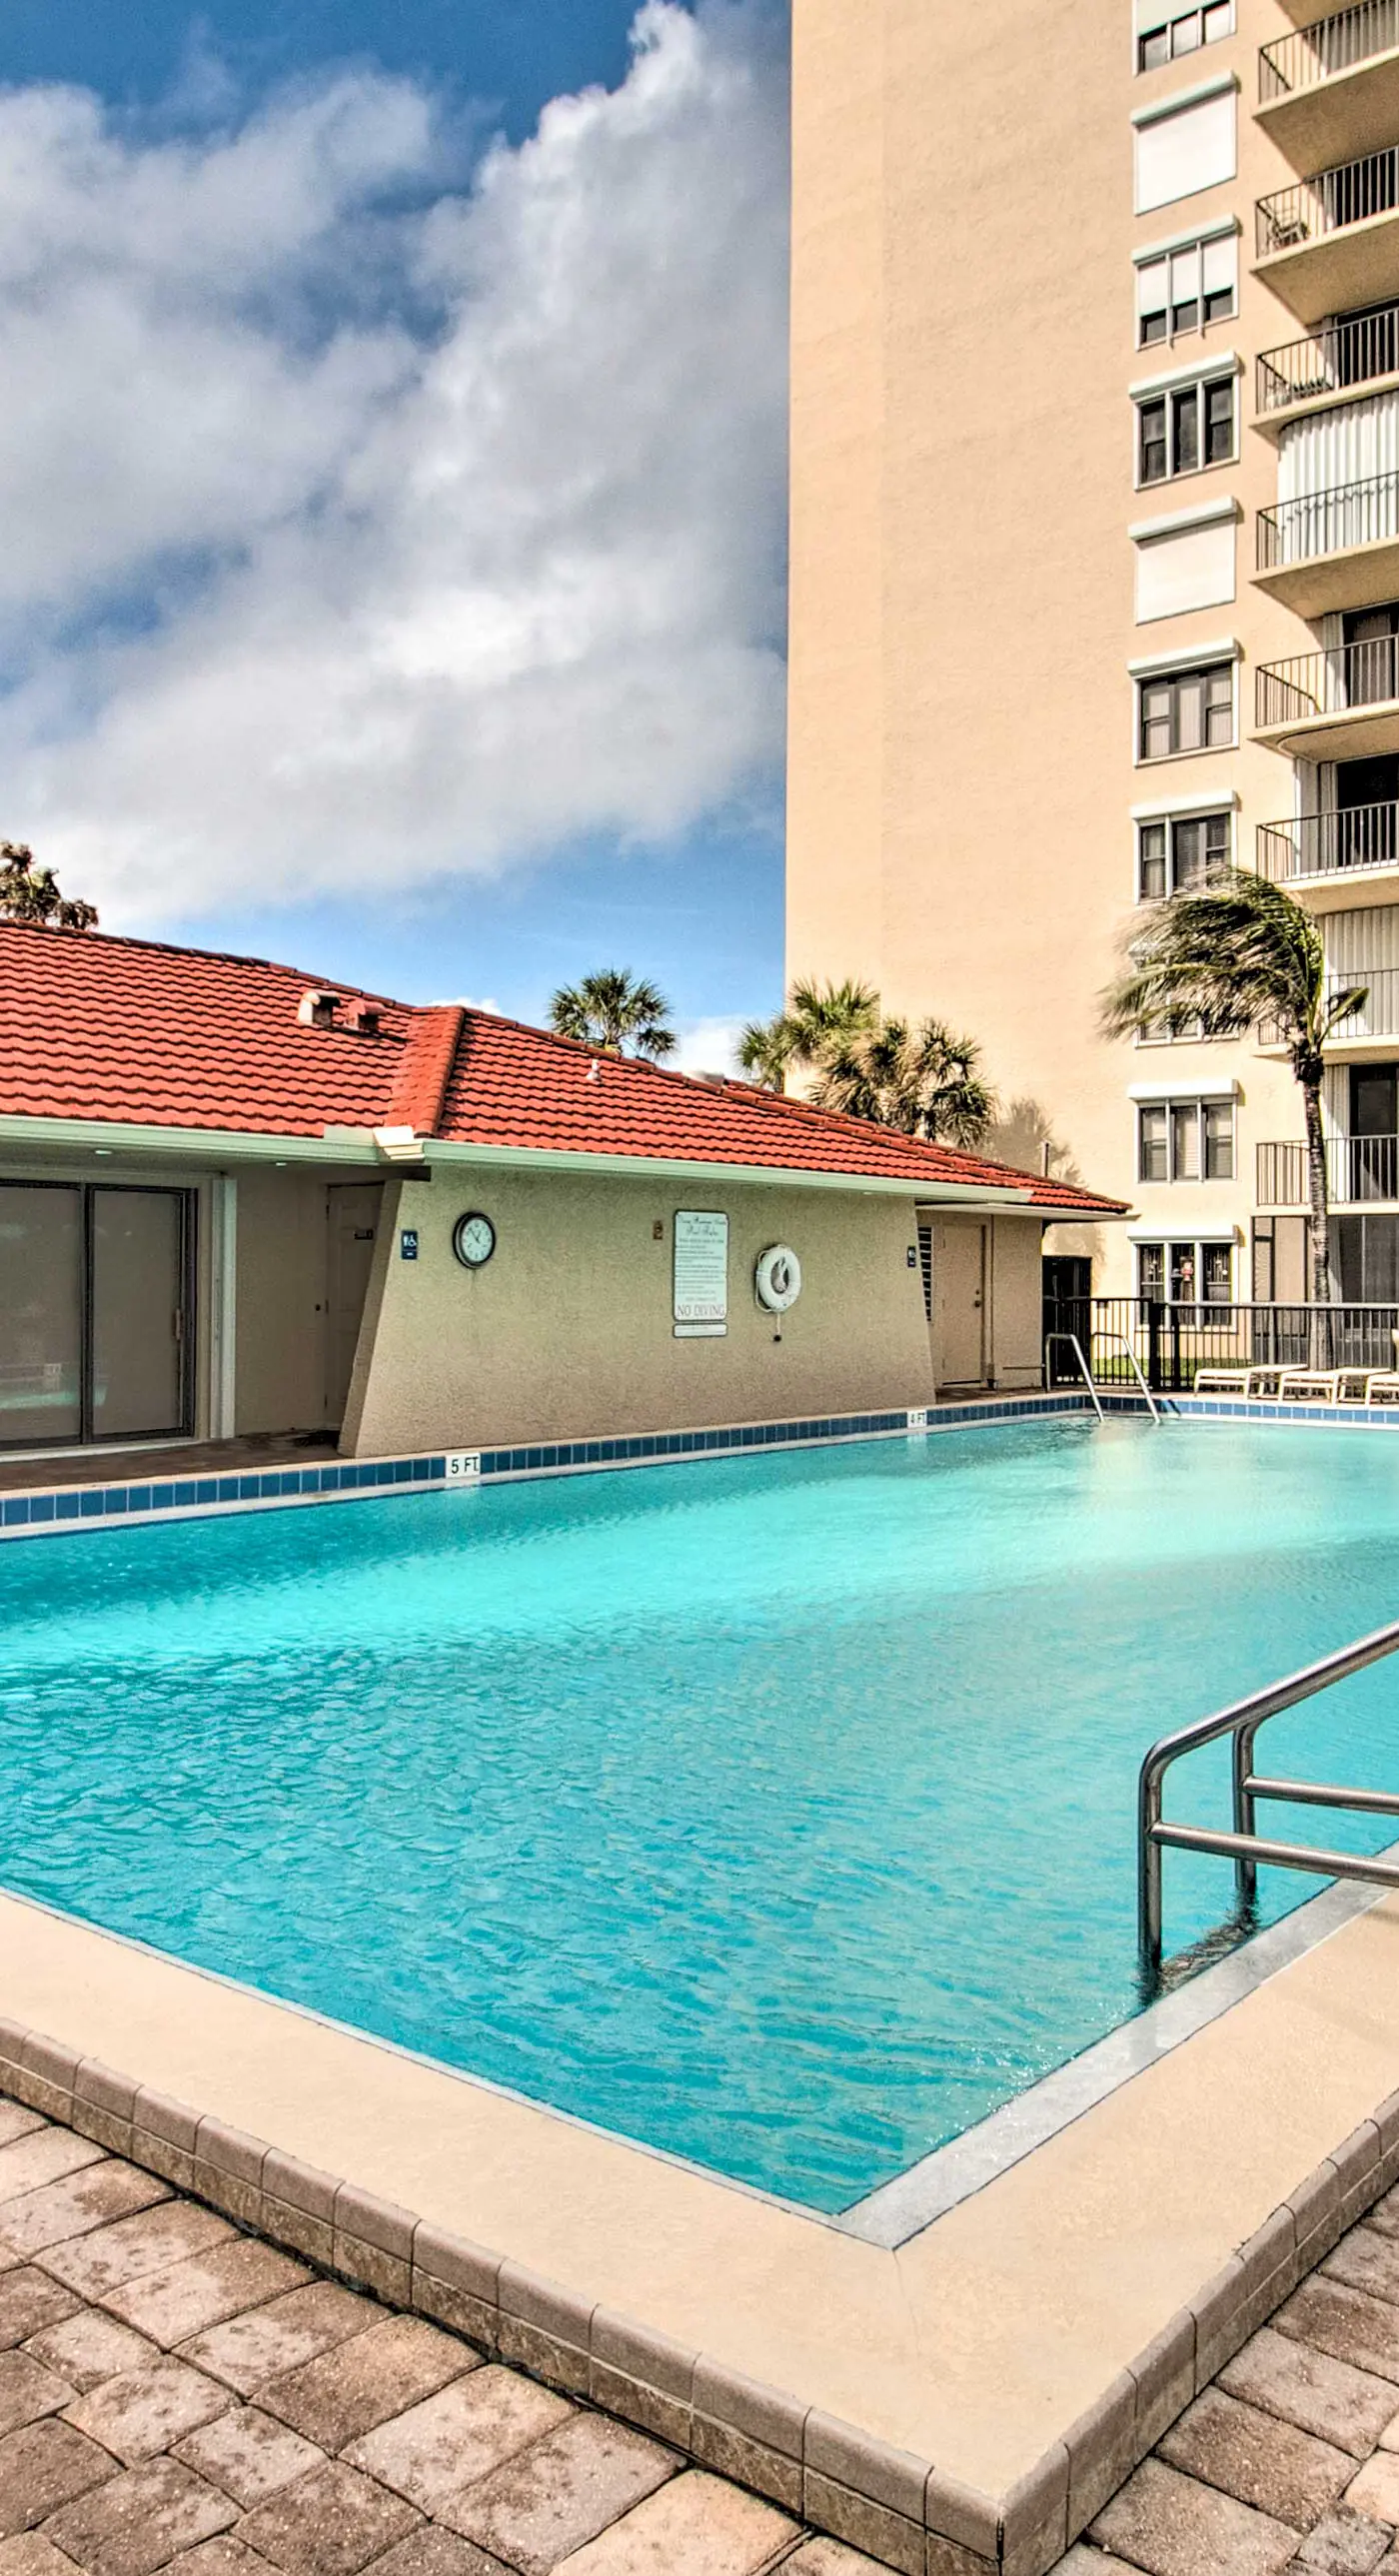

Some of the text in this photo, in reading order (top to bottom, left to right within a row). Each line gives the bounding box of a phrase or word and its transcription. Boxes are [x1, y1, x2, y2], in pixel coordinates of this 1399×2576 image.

[677, 1303, 724, 1317] NO DIVING
[452, 1458, 459, 1474] 5
